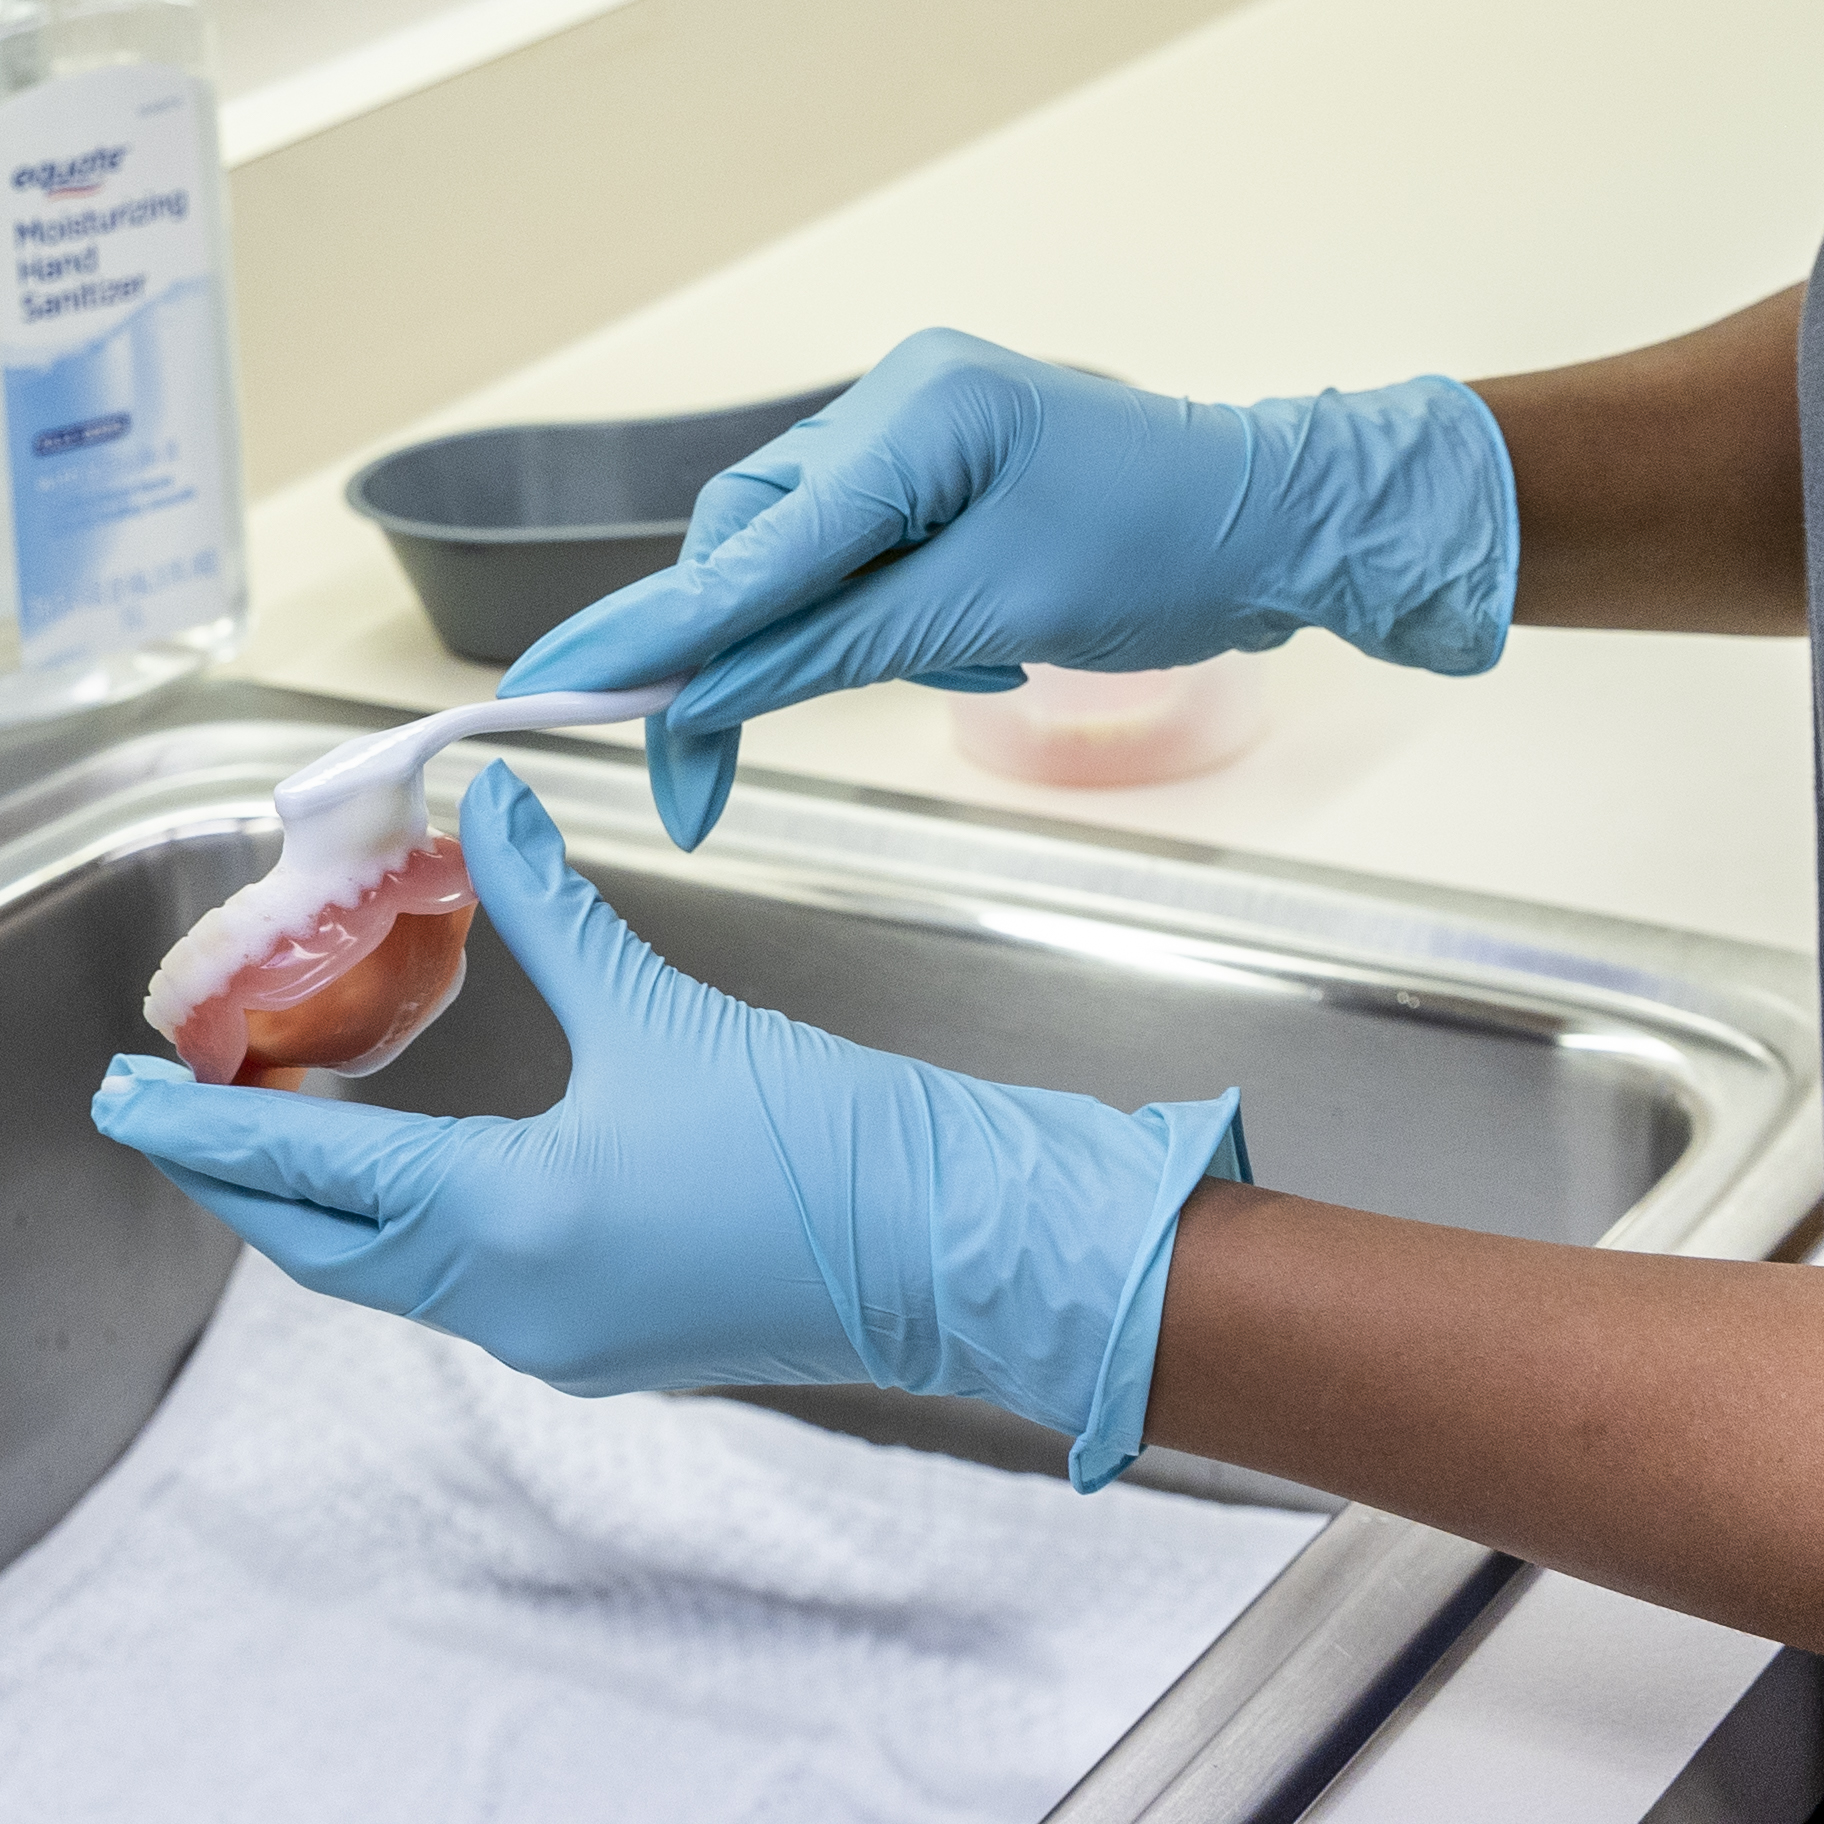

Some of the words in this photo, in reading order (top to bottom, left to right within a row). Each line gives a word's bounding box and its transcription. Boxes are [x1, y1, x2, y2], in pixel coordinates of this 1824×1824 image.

[11, 143, 128, 189] equate
[15, 190, 188, 247] Moisturizing
[17, 244, 97, 286] Hand
[22, 273, 144, 323] Sanitizer
